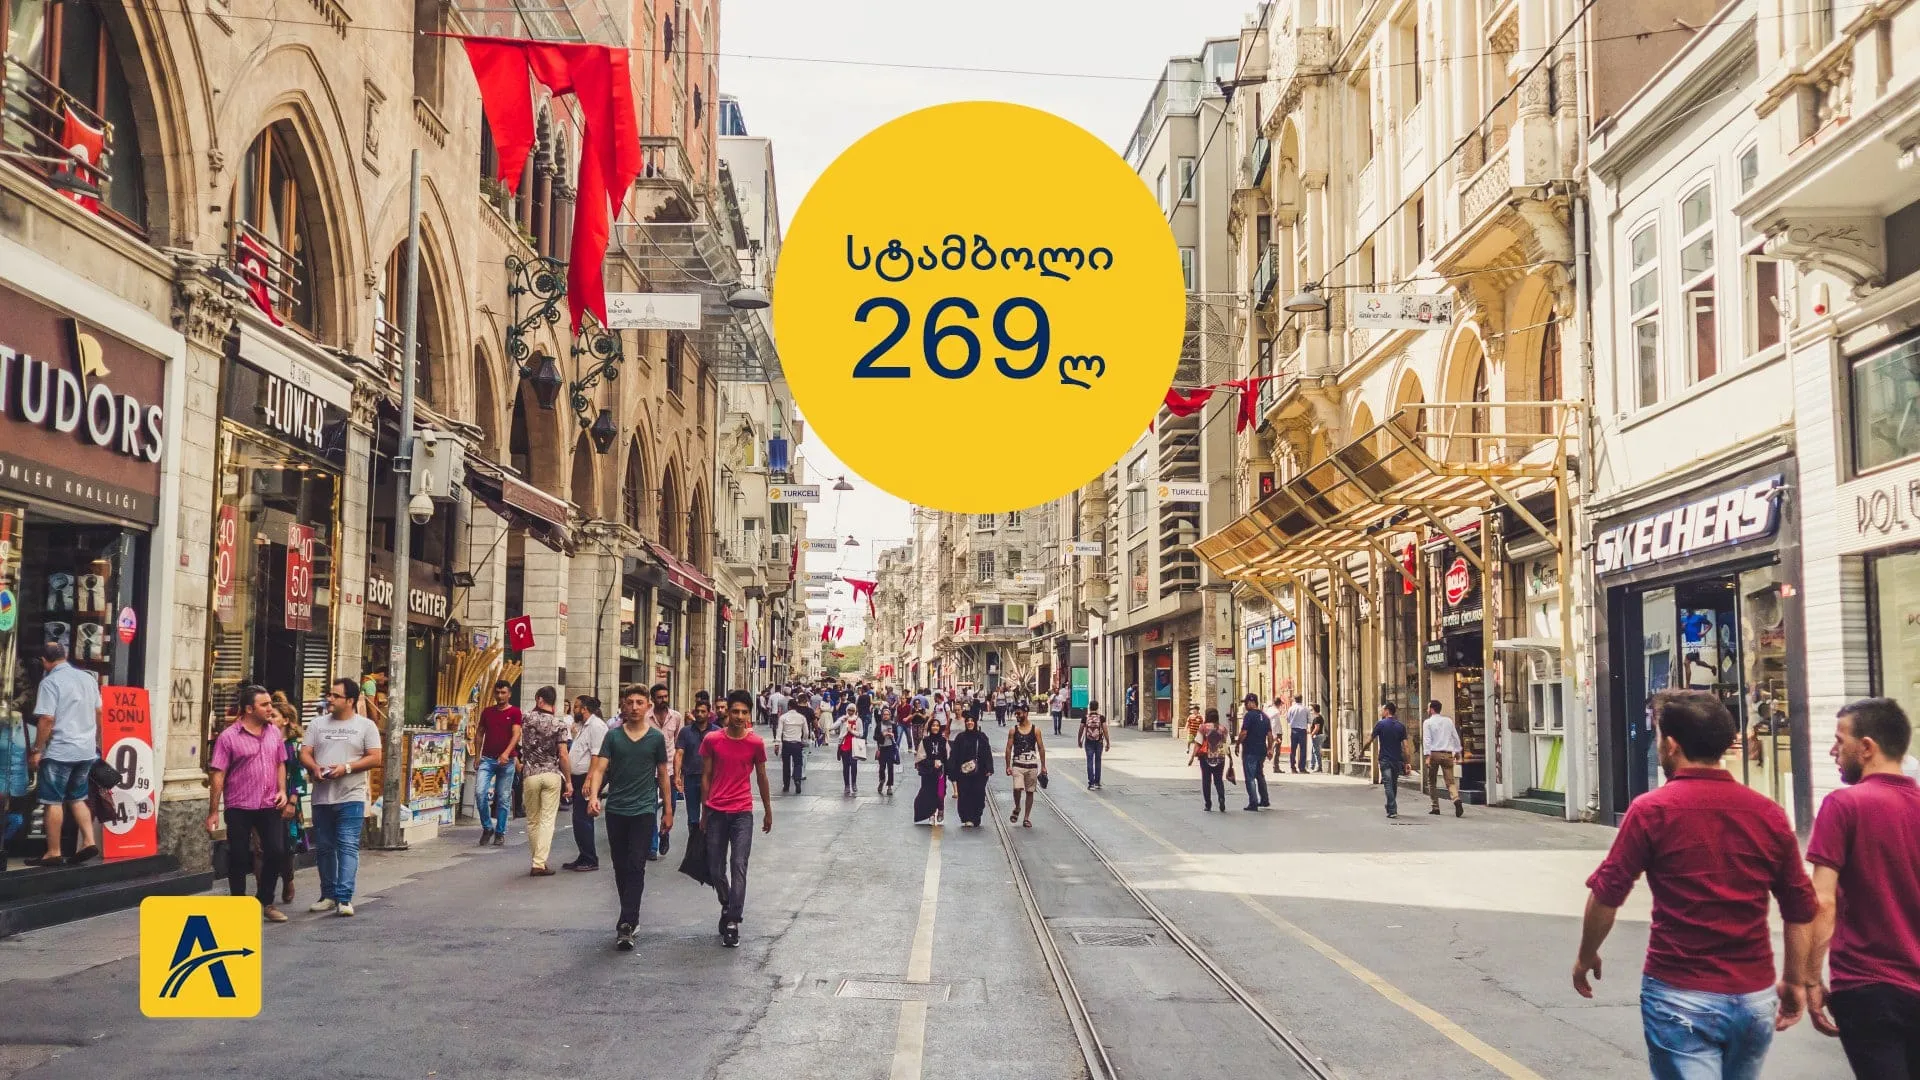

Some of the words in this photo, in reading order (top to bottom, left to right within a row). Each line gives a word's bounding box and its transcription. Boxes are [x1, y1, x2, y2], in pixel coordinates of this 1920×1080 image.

[0, 344, 162, 463] TUDORS
[264, 374, 328, 449] FLOWER
[1171, 488, 1209, 496] TURKCELL
[1595, 479, 1774, 575] SKECHERS
[291, 565, 309, 598] 50
[409, 588, 447, 619] CENTER
[114, 692, 137, 707] YAZ
[173, 678, 193, 699] NO
[108, 709, 144, 723] SONU
